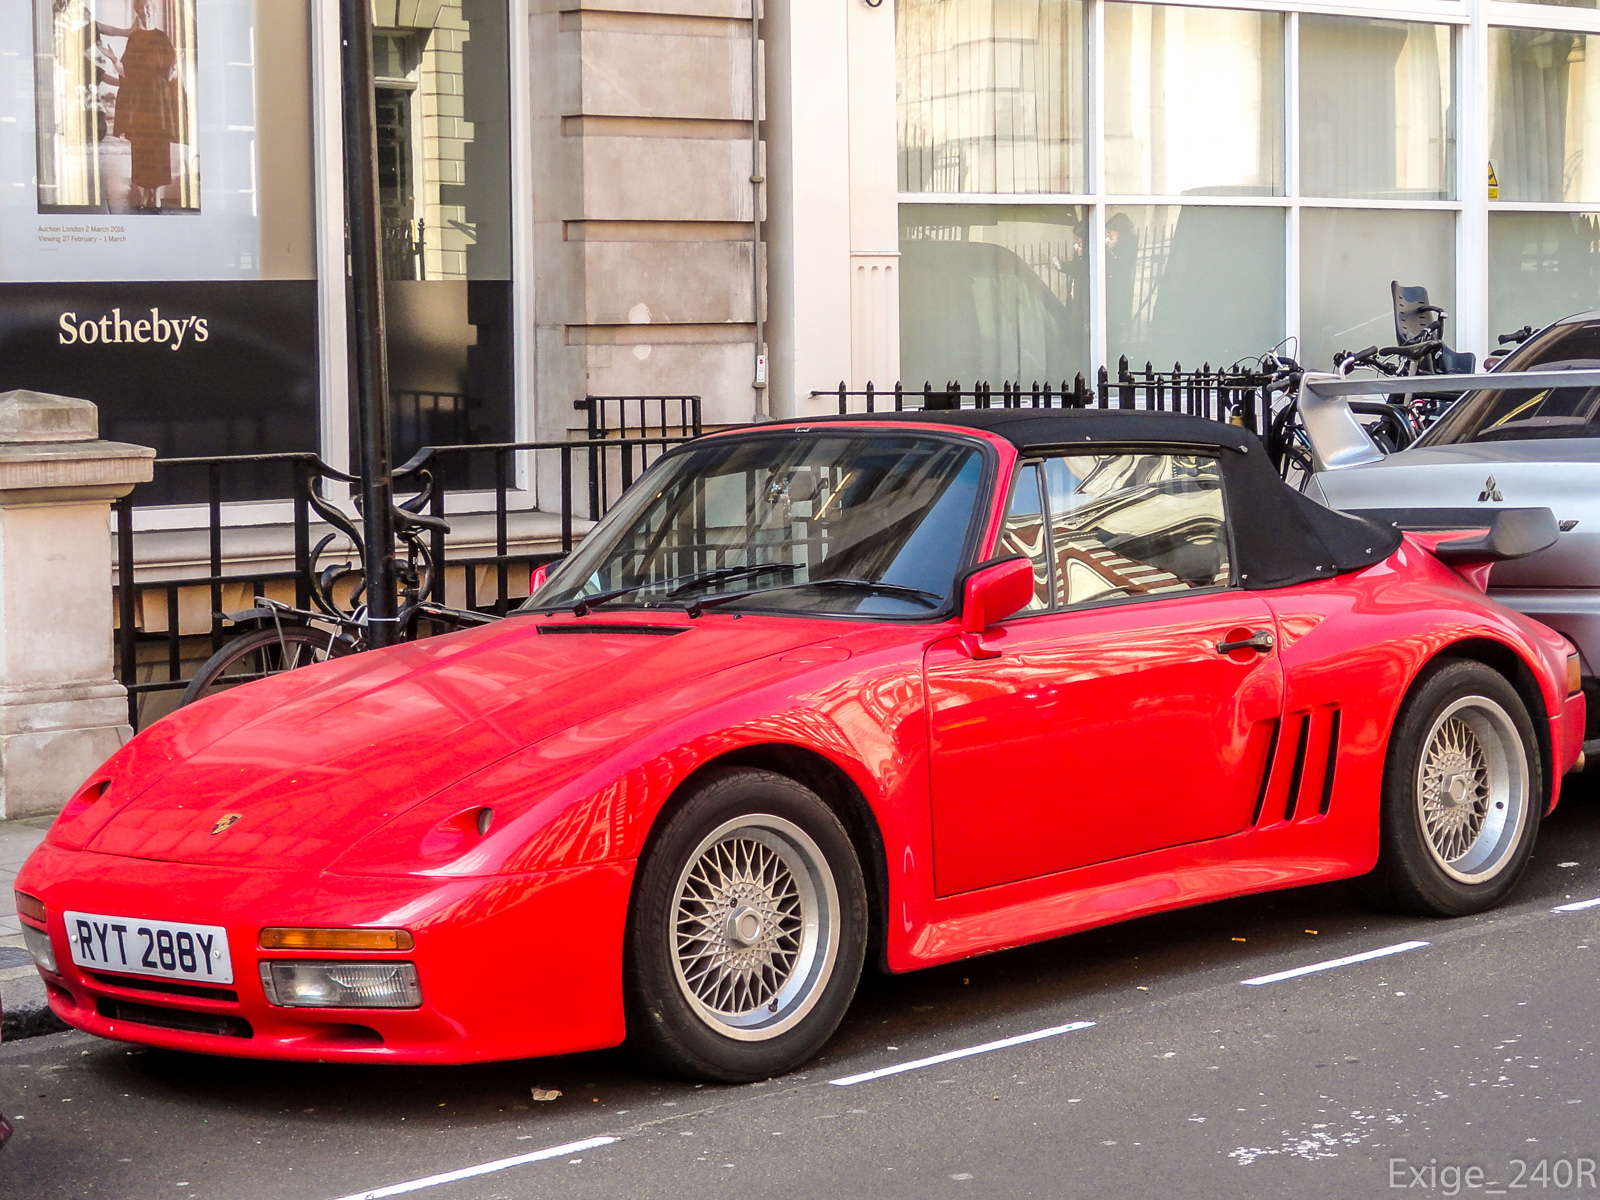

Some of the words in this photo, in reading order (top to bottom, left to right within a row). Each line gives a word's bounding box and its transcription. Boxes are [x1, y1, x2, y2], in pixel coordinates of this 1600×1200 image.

[38, 235, 61, 244] Viewing
[71, 235, 97, 244] February
[58, 307, 209, 351] Sotheby's
[76, 919, 128, 965] RYT
[137, 927, 214, 975] 288Y
